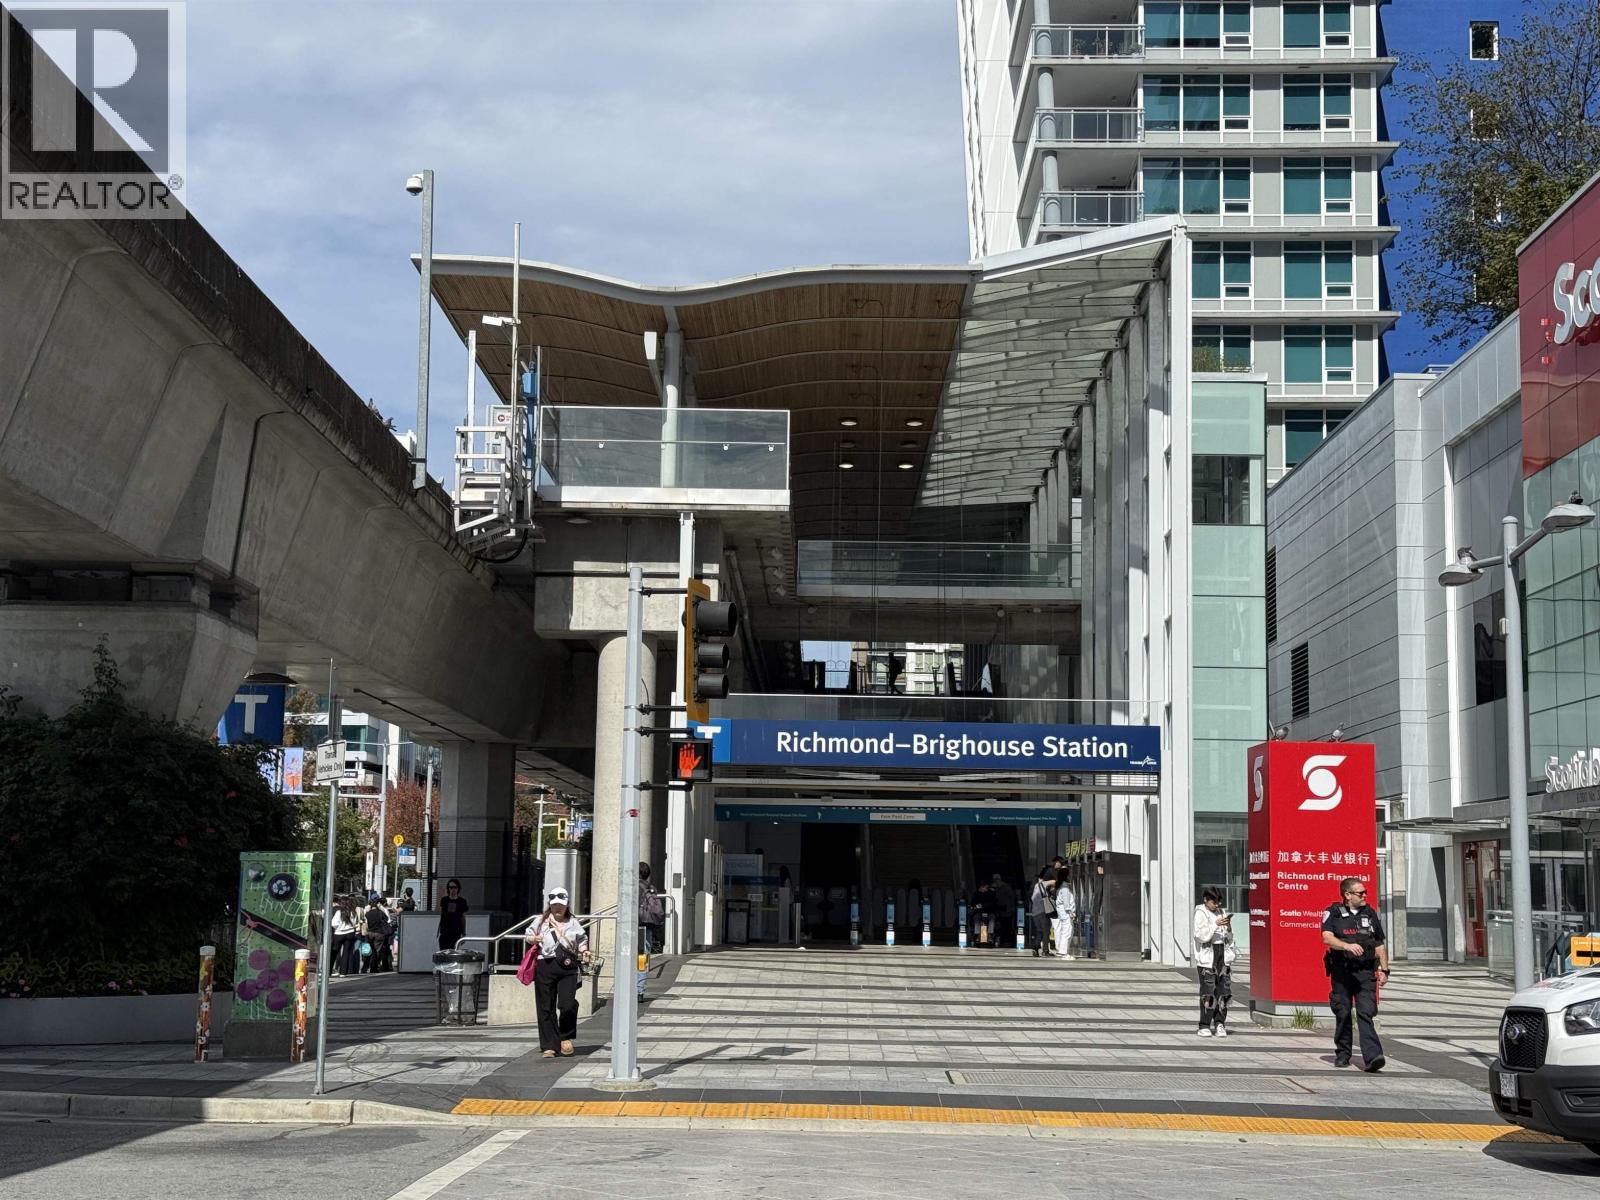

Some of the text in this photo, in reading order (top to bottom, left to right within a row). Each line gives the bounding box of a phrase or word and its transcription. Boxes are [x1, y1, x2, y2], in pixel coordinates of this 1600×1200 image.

[234, 694, 269, 734] T
[1043, 735, 1128, 758] Station
[1277, 850, 1370, 865] 加拿大丰业银行
[1277, 871, 1325, 881] Richmond
[1277, 881, 1309, 891] Centre
[1279, 909, 1302, 917] Scotia
[1279, 920, 1321, 929] Commercial
